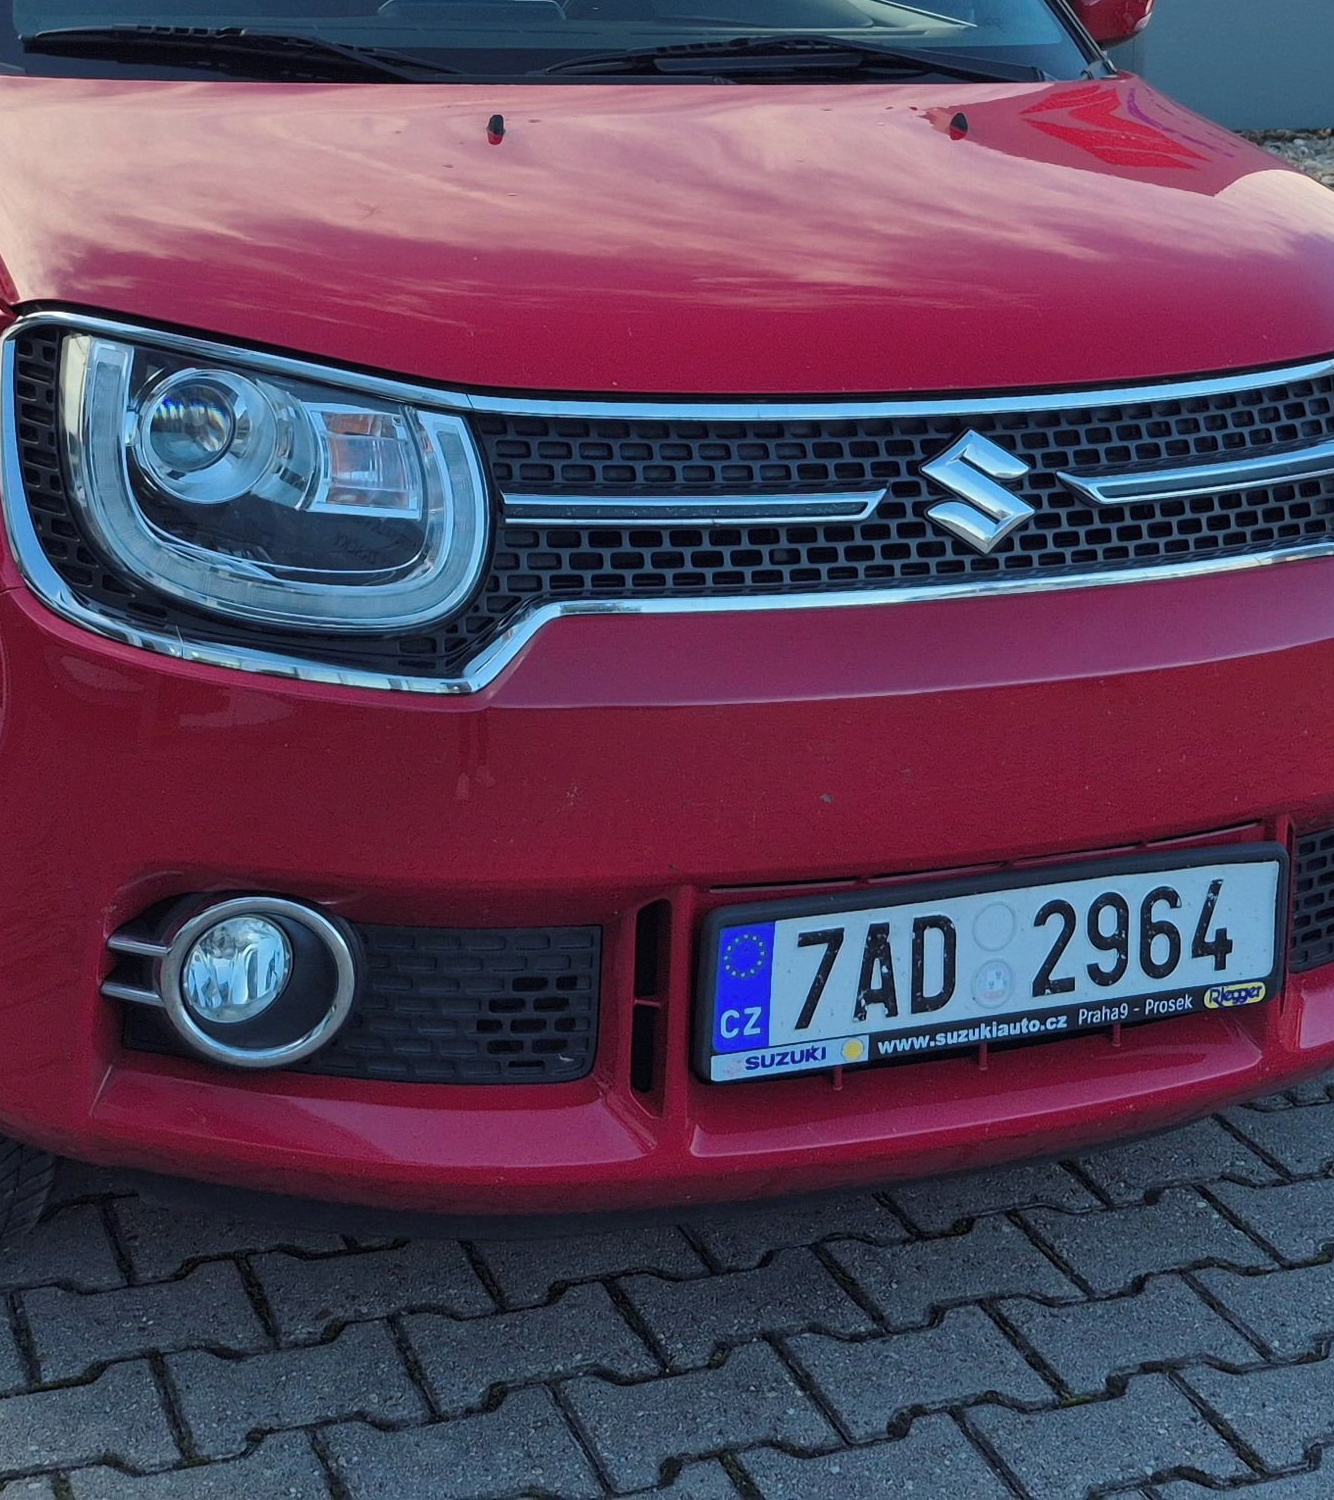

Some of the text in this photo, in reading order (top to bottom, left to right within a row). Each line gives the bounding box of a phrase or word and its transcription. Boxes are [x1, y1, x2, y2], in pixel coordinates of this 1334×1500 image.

[796, 878, 1234, 1031] 7AD 2964
[719, 1006, 762, 1039] CZ
[744, 1046, 827, 1071] SUZUKI
[877, 1014, 1068, 1054] www.suzukiauto.cz
[1078, 1002, 1129, 1025] Praha9
[1145, 994, 1193, 1015] Prosek
